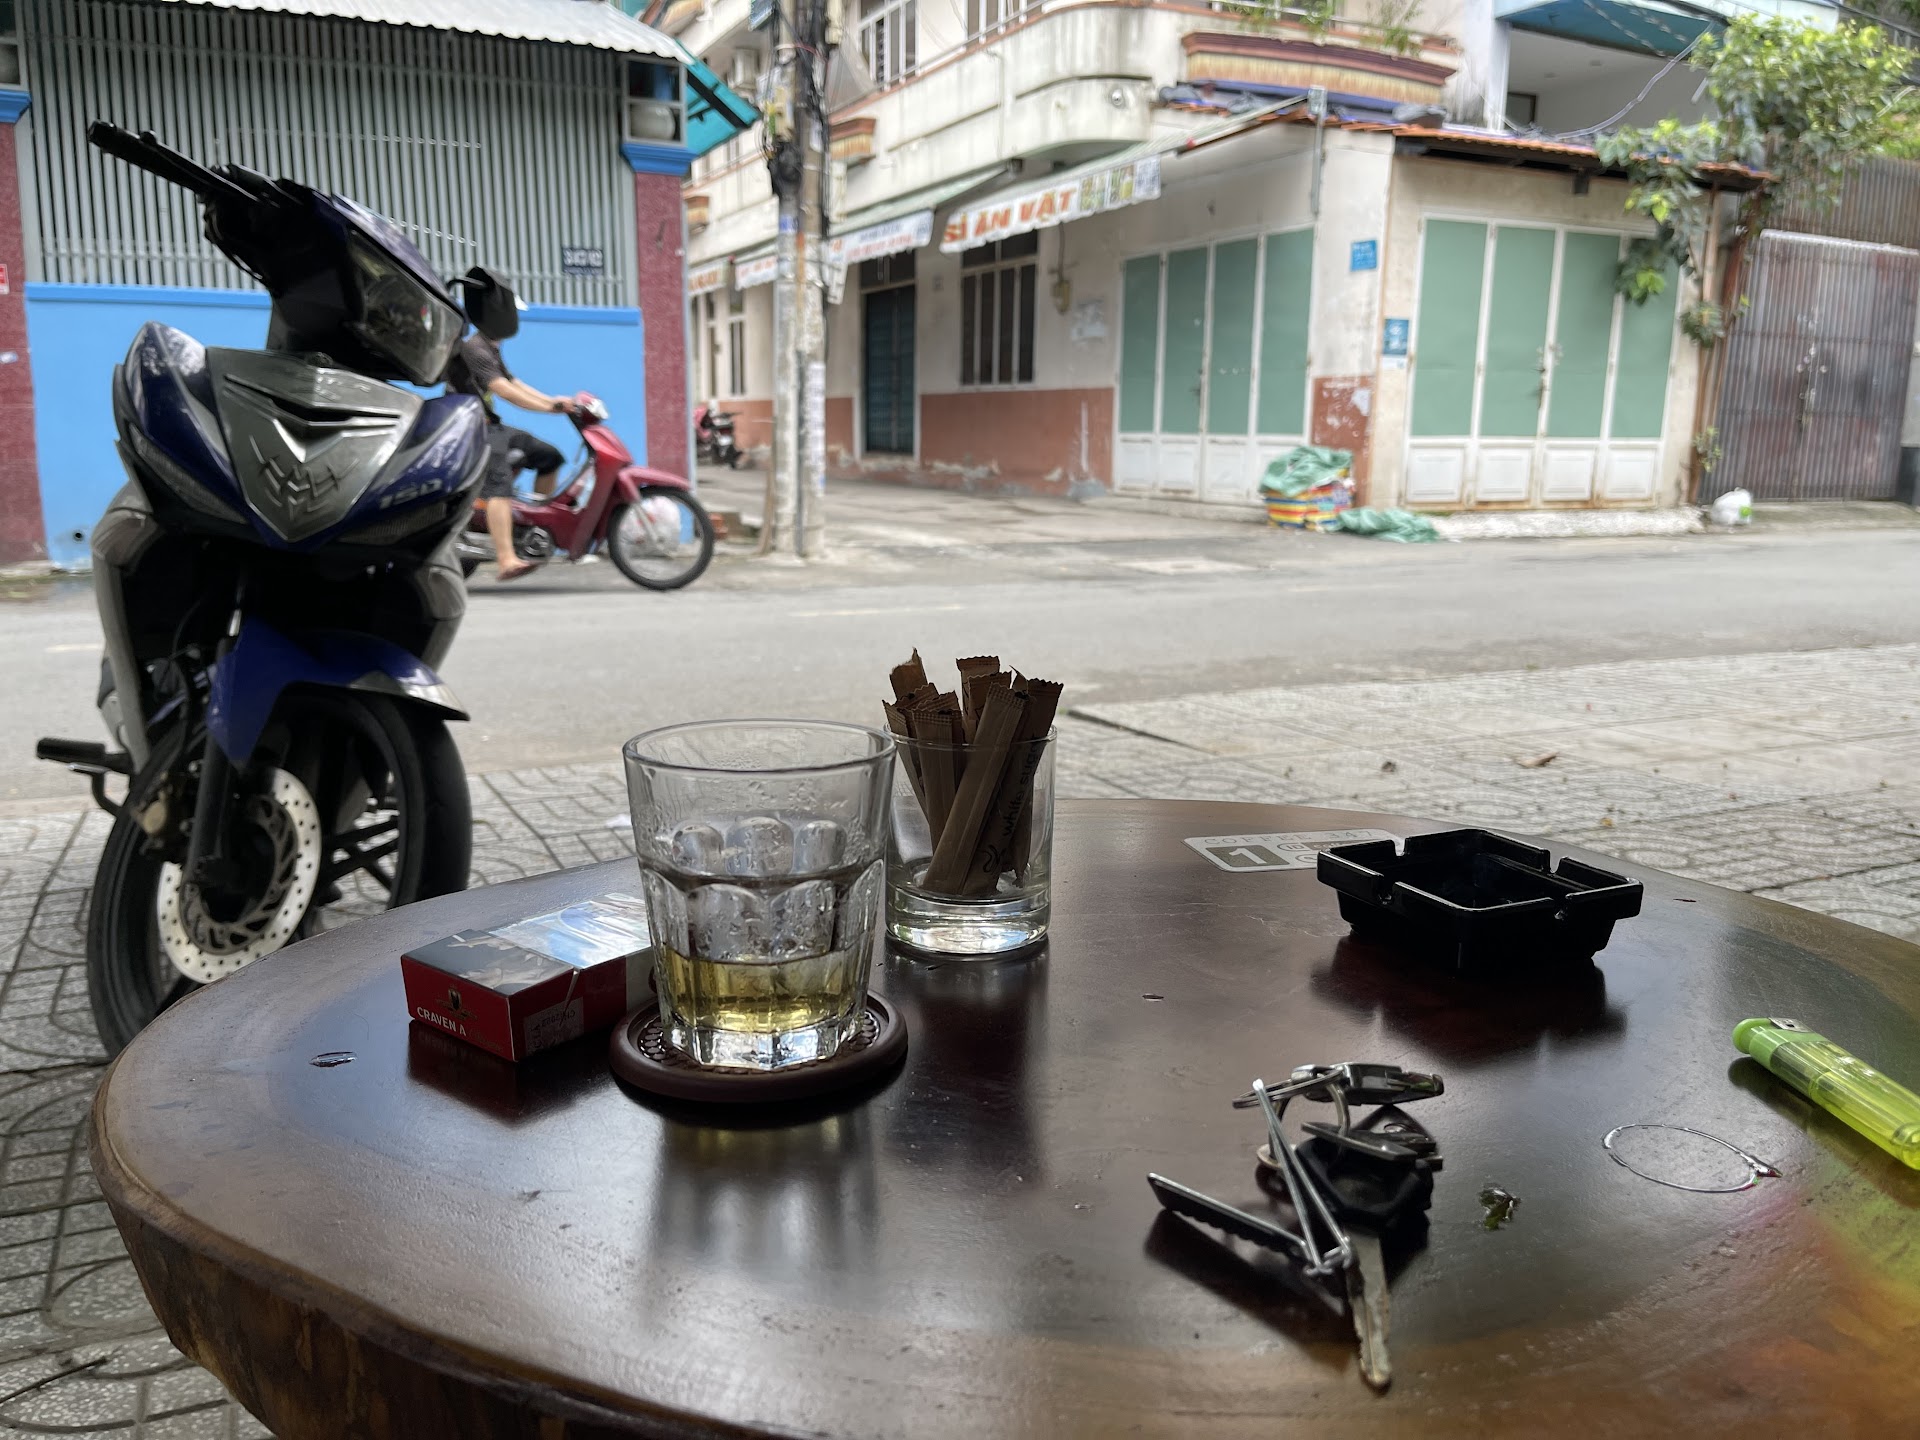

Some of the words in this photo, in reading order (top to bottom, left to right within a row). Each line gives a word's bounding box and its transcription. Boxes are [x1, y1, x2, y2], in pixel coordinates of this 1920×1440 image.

[1003, 791, 1025, 837] white
[1204, 832, 1312, 845] COFFEE
[1327, 830, 1372, 839] 347
[1229, 847, 1267, 865] 1
[416, 1006, 457, 1032] CRAVEN
[459, 1024, 467, 1037] A
